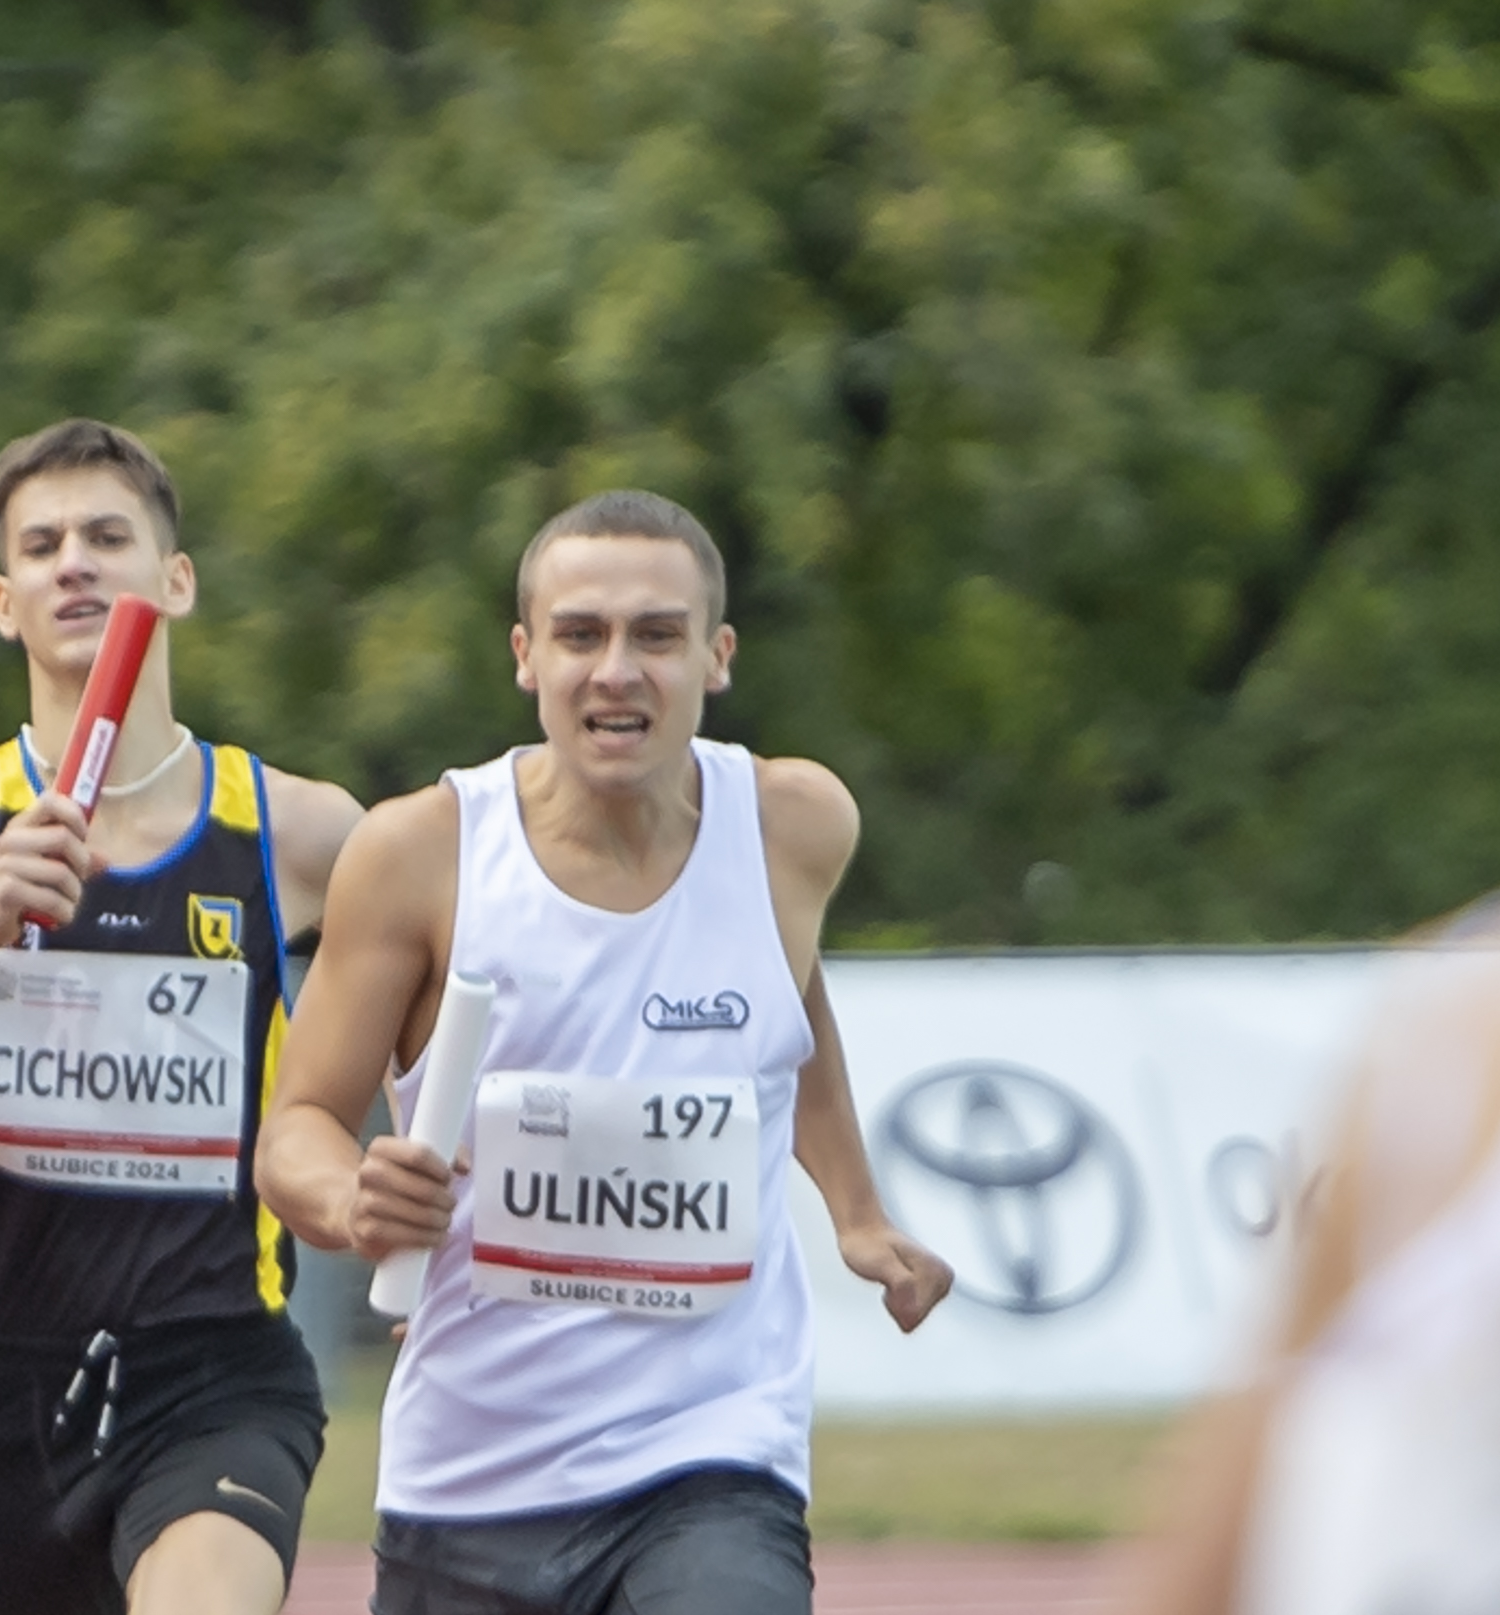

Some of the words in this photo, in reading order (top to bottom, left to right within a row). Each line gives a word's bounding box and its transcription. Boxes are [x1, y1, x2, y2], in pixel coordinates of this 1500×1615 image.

[146, 971, 208, 1016] 67
[641, 1093, 734, 1140] 197
[24, 1154, 119, 1178] SŁUBICE
[124, 1159, 181, 1181] 2024
[503, 1167, 730, 1232] ULIŃSKI
[529, 1277, 628, 1305] SŁUBICE
[633, 1287, 694, 1310] 2024
